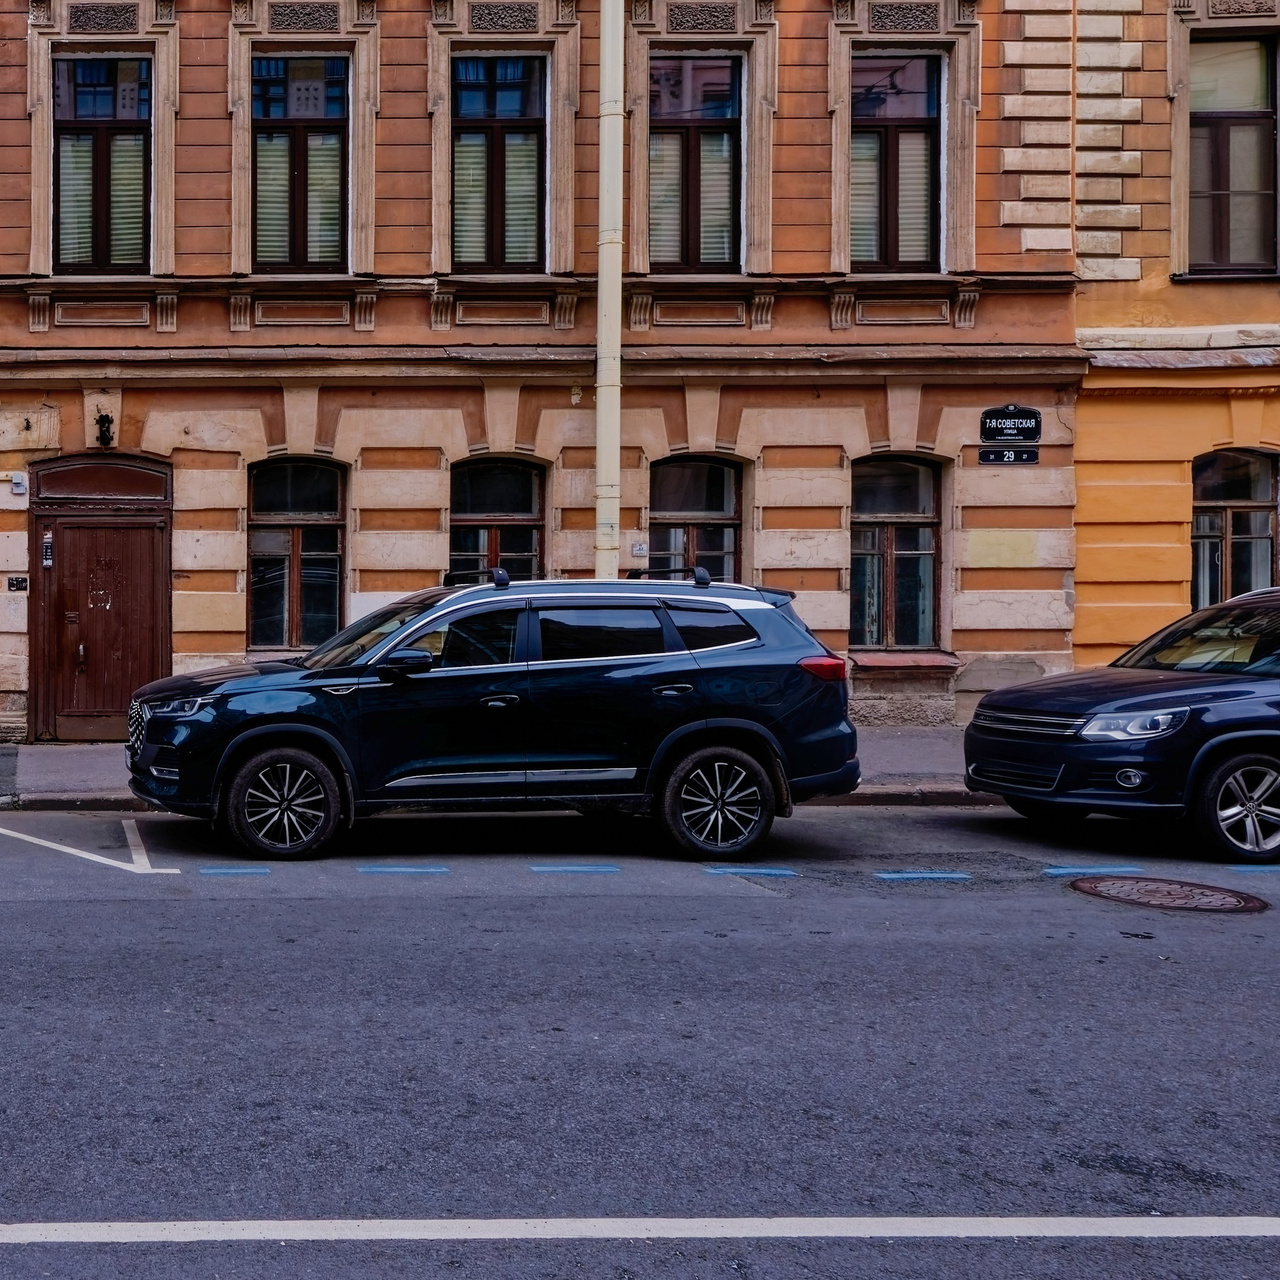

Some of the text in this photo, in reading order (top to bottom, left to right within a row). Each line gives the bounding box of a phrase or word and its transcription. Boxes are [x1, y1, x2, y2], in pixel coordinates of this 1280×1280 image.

[986, 419, 1035, 428] 7-Я СОВЕТСКАЯ
[1003, 451, 1014, 461] 29
